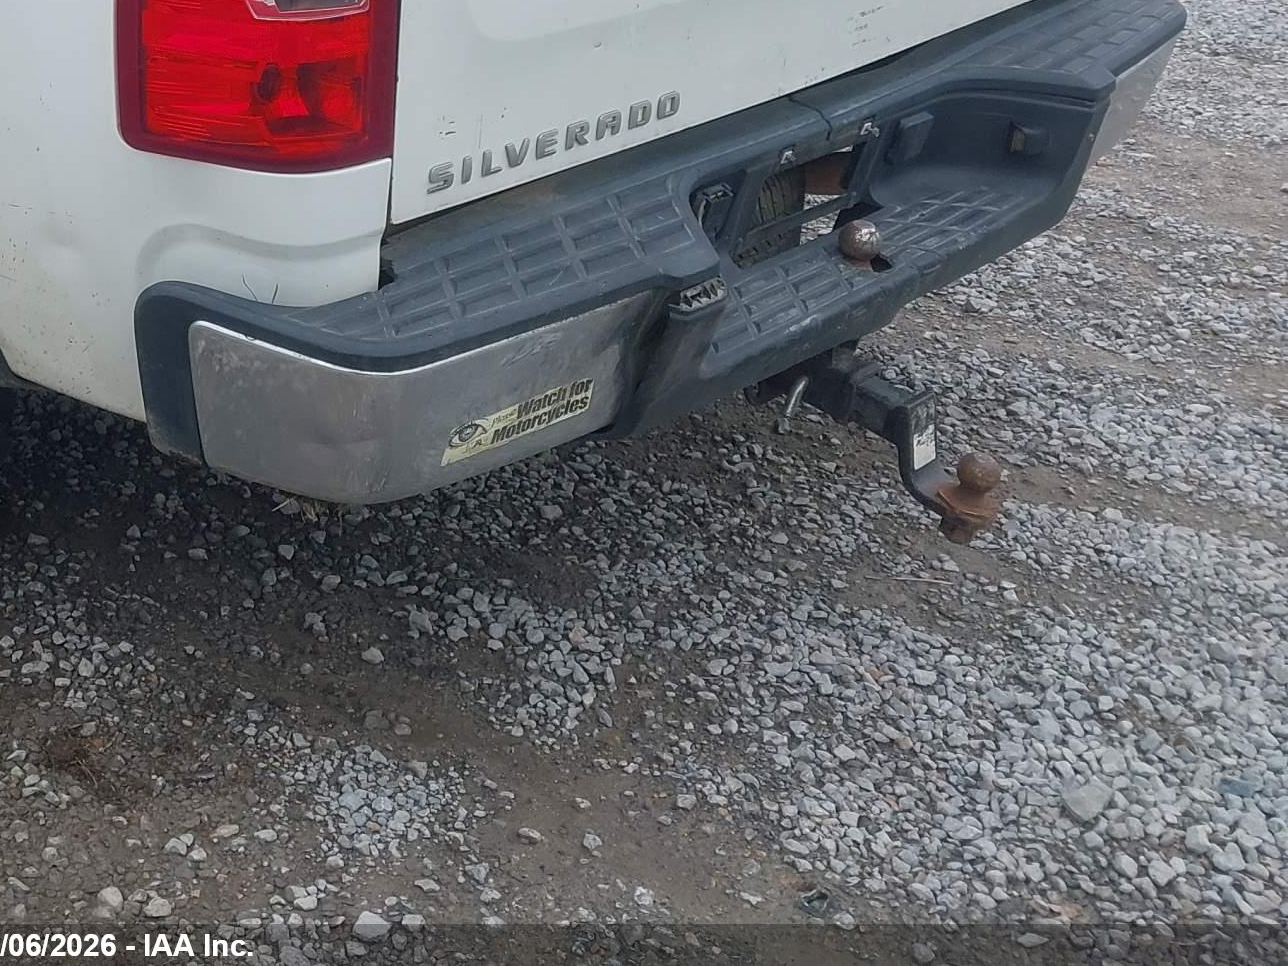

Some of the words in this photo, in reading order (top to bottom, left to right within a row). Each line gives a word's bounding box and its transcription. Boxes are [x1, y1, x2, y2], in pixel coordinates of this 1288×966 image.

[426, 91, 681, 194] SILVERADO
[490, 395, 590, 444] Motorcycles
[516, 387, 568, 419] Watch
[569, 379, 594, 397] for
